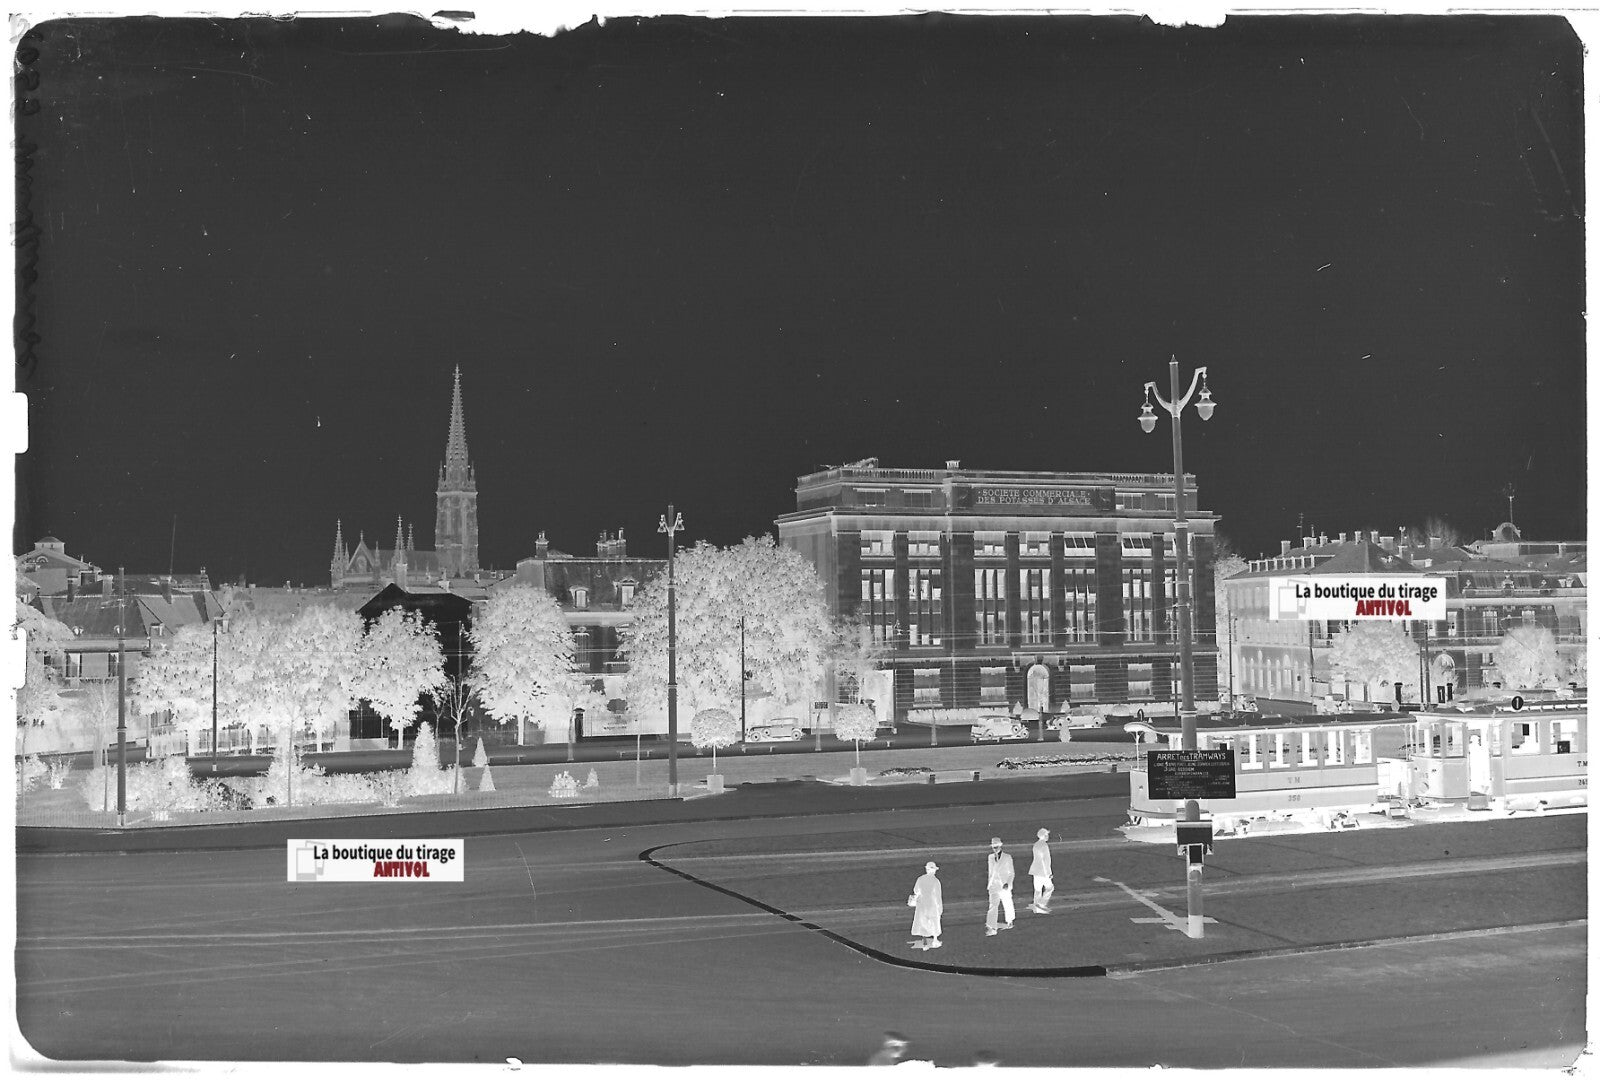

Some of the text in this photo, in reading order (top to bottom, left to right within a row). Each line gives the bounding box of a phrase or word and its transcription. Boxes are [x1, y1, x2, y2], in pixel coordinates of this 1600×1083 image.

[982, 488, 1020, 497] SOCIETE
[978, 496, 995, 504] DES
[1189, 752, 1227, 760] TRAMWAYS
